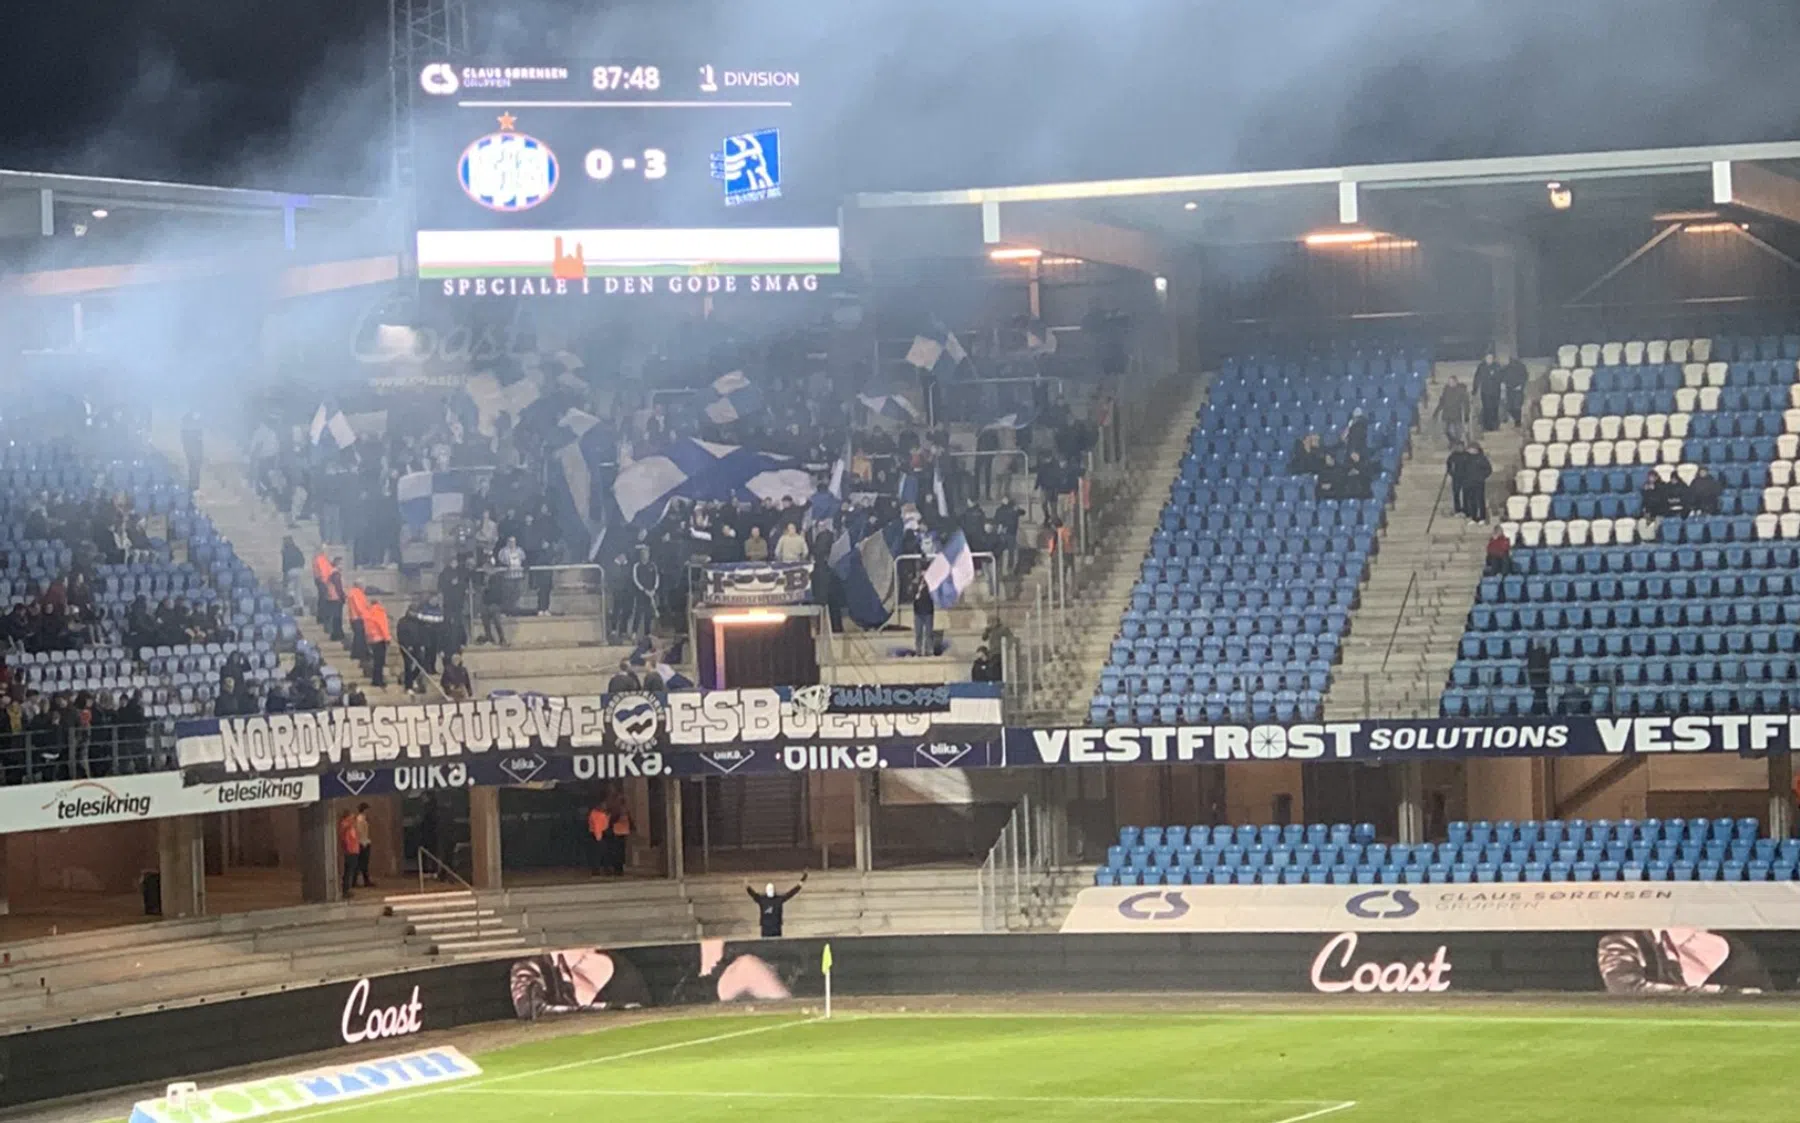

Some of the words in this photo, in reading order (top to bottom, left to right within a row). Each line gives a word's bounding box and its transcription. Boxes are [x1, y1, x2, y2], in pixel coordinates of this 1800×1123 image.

[462, 67, 501, 79] CLAUS
[504, 67, 569, 79] SØRENSEN
[592, 66, 660, 90] 87:48
[724, 71, 800, 86] DIVISION
[585, 149, 612, 180] 0
[644, 149, 668, 180] 3
[443, 276, 568, 296] SPECIALE
[582, 277, 590, 294] I
[605, 275, 654, 294] DEN
[669, 275, 737, 293] GODE
[751, 274, 819, 292] SMAG
[218, 695, 603, 773] NORDVESTKURVE
[1033, 723, 1361, 764] VESTFROST
[1369, 725, 1569, 750] SOLUTIONS
[217, 779, 304, 804] telesikring
[58, 792, 152, 819] telesikring
[1435, 901, 1541, 912] GRUPPEN
[1439, 891, 1522, 902] CLAUS
[1535, 889, 1674, 901] SØRENSEN
[1310, 931, 1453, 993] Coast
[341, 977, 423, 1043] Coast
